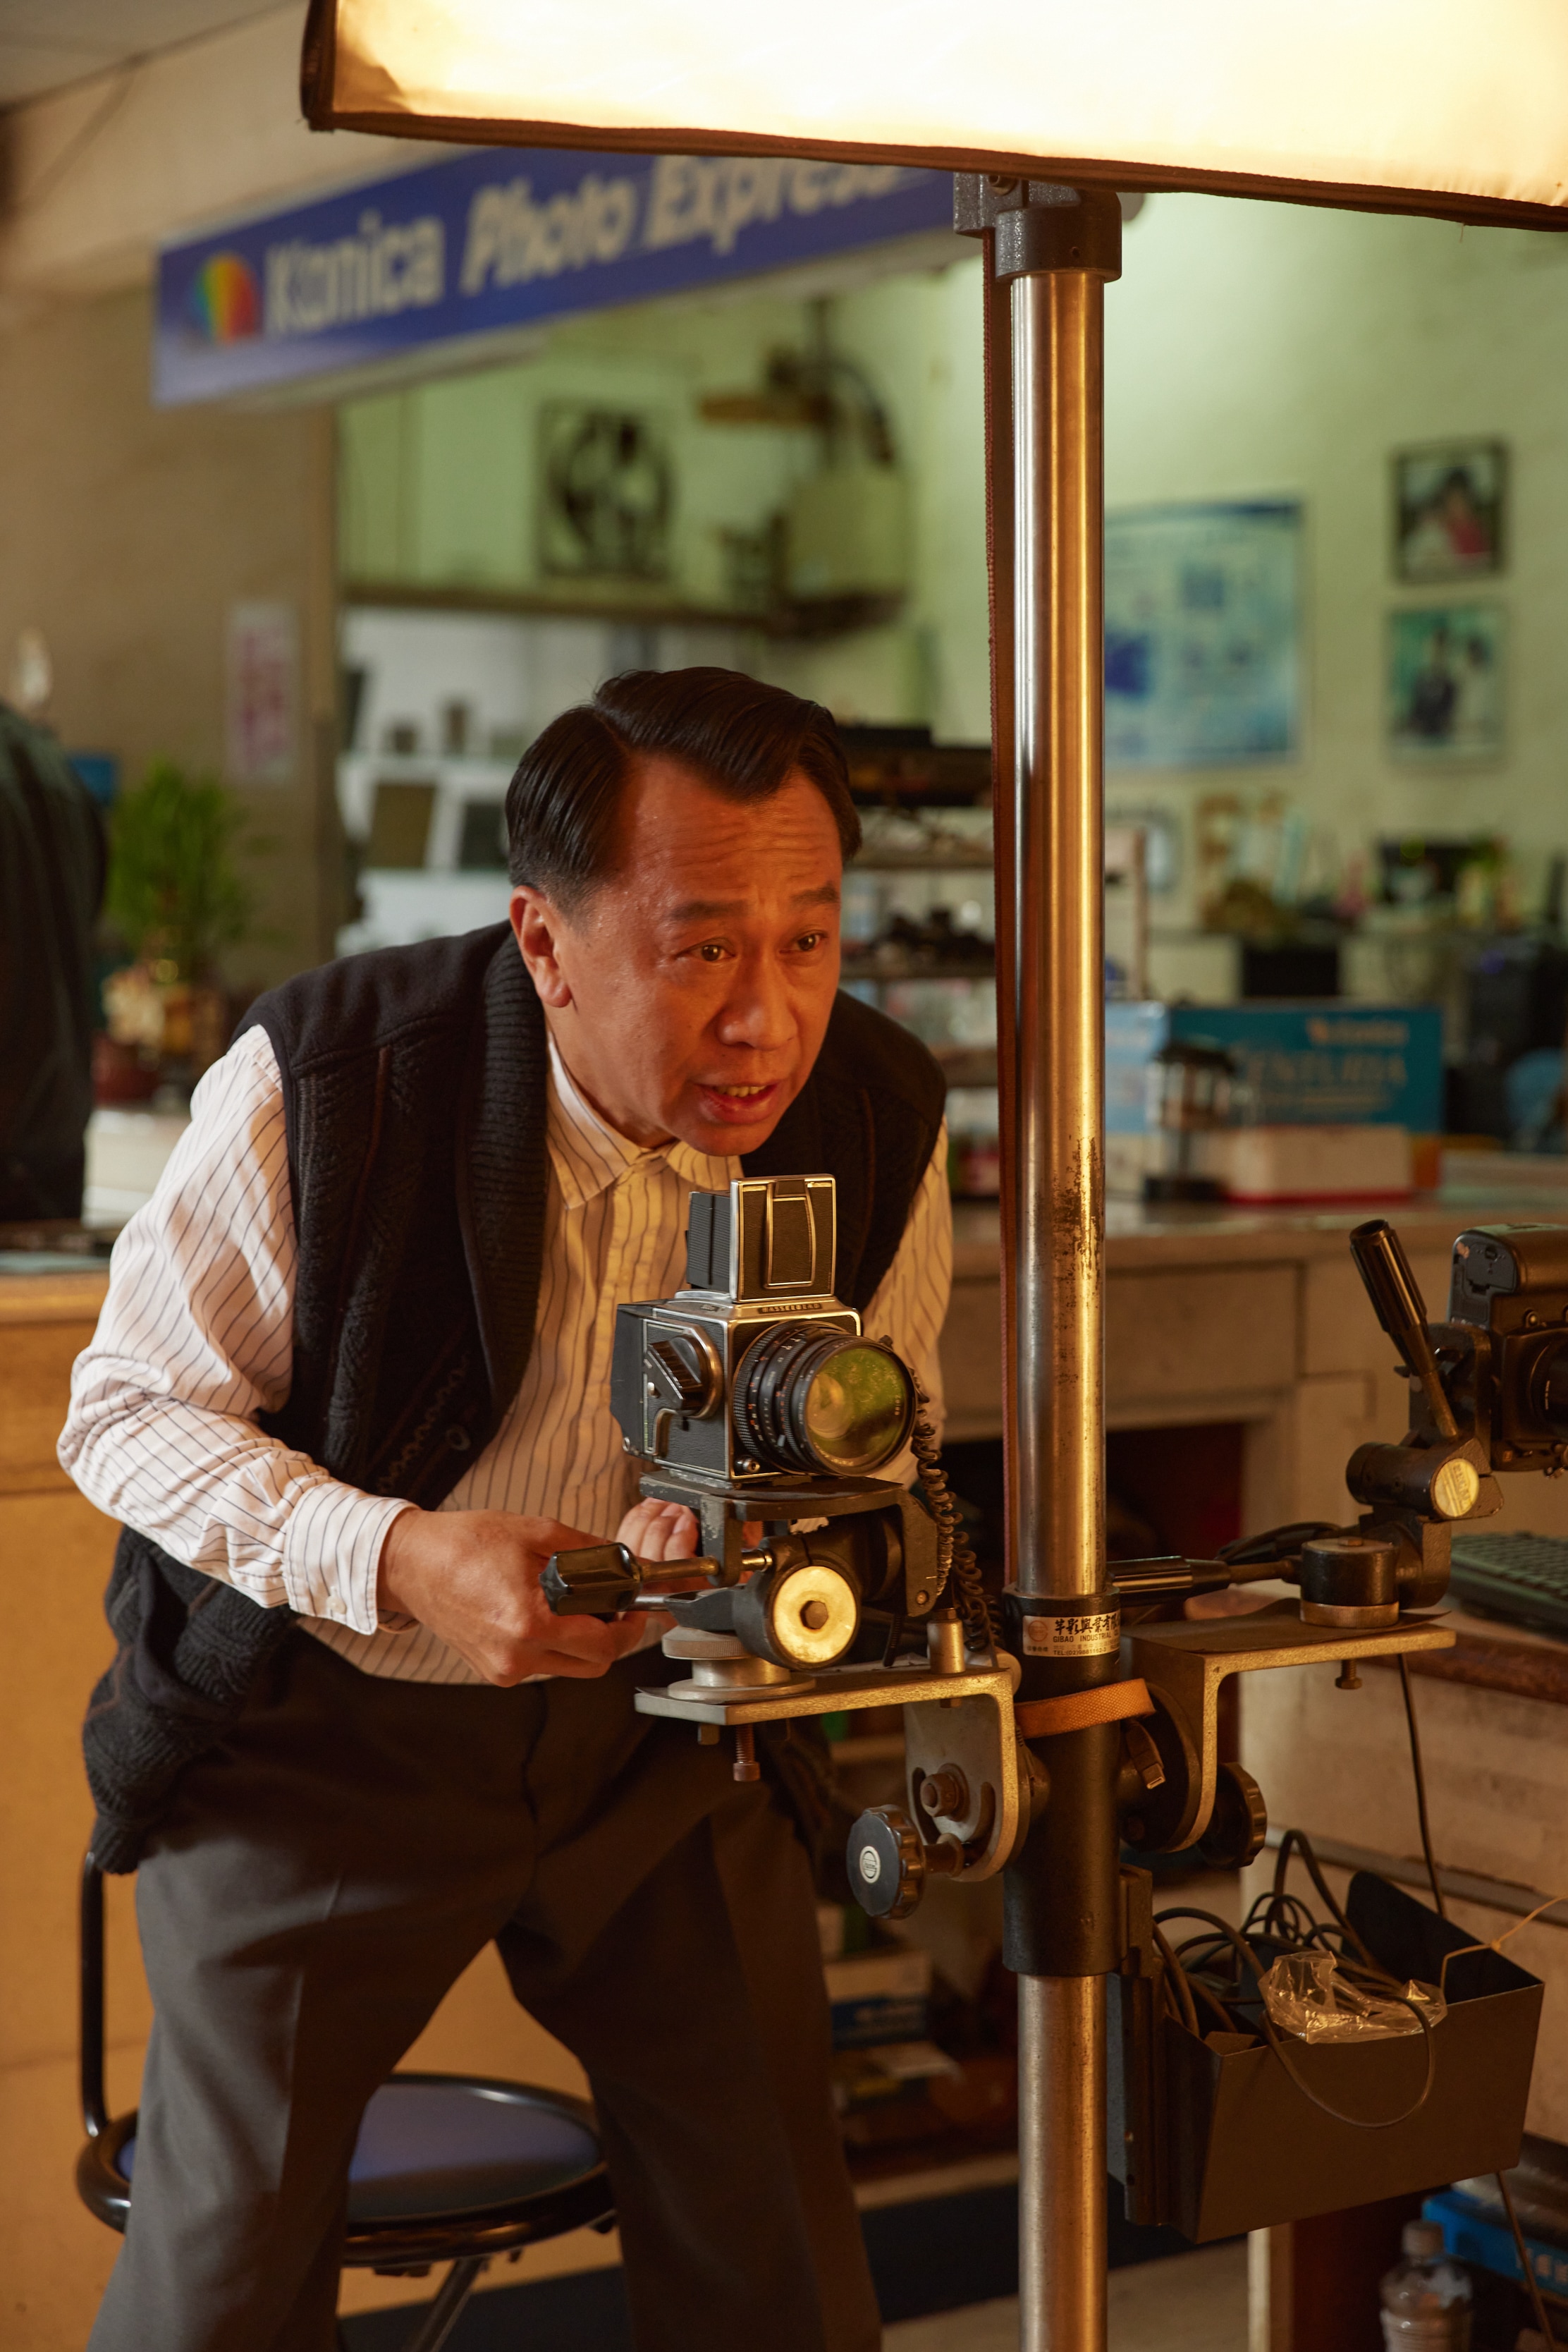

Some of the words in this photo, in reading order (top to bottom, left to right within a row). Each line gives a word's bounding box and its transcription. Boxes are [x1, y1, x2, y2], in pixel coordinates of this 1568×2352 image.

[265, 214, 444, 334] Konica
[460, 175, 637, 296] Photo
[761, 1303, 820, 1313] HASSELBLAD
[1079, 1633, 1112, 1642] INDUSTRIAL
